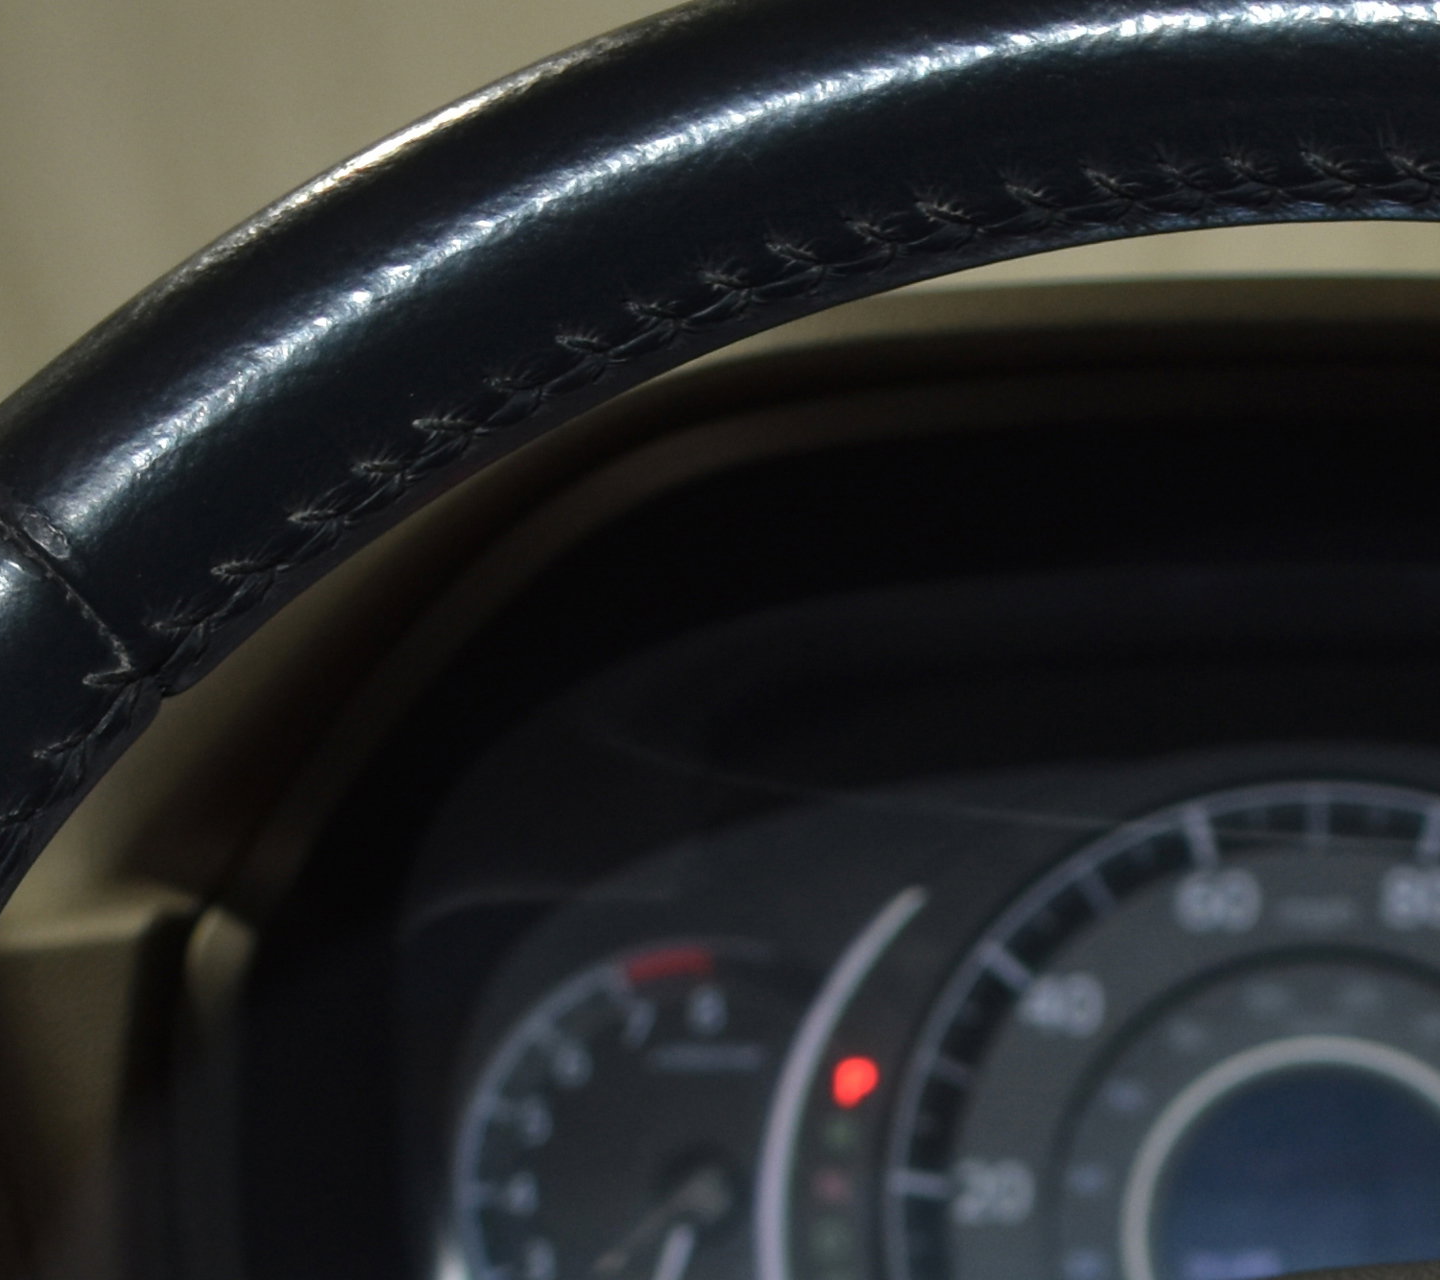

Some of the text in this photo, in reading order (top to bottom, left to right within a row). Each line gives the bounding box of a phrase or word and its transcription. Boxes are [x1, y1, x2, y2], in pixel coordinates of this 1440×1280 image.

[1174, 866, 1262, 931] 60
[1019, 973, 1105, 1037] 40
[952, 1159, 1037, 1225] 20
